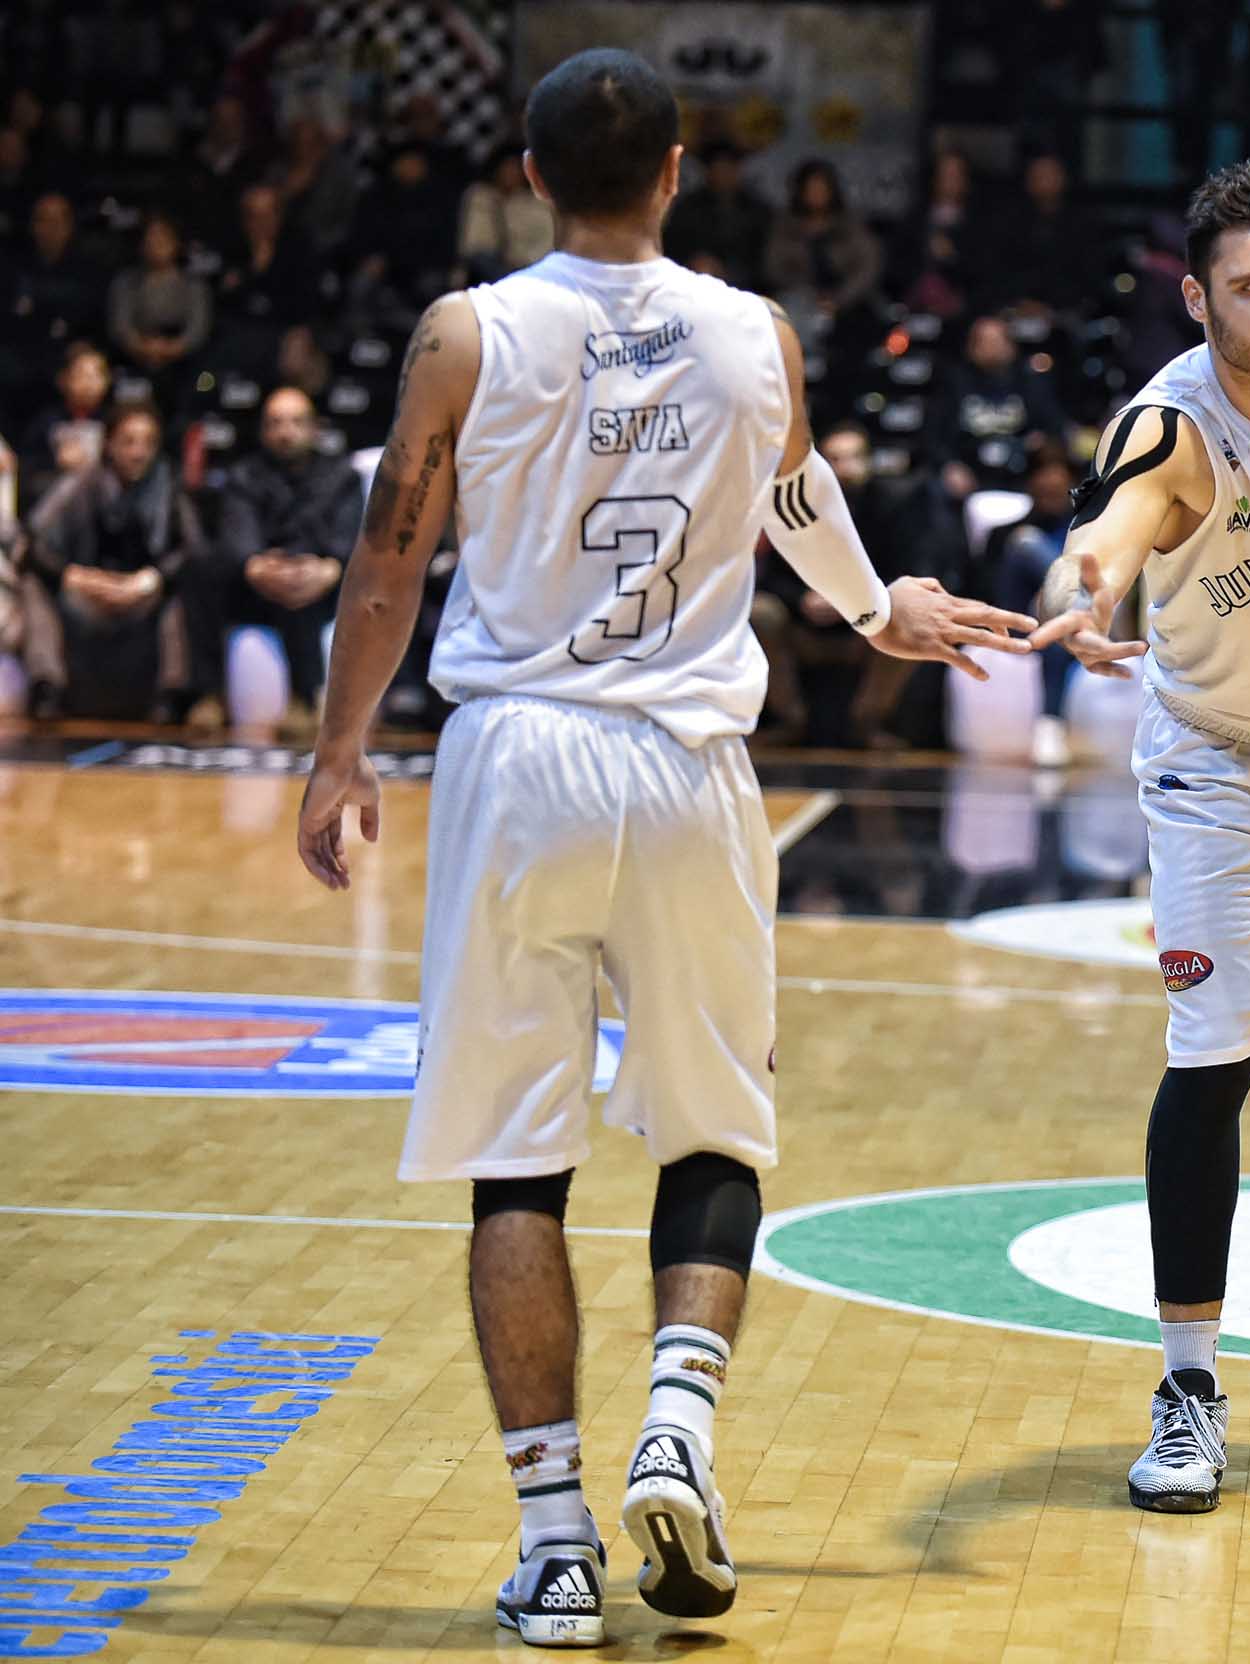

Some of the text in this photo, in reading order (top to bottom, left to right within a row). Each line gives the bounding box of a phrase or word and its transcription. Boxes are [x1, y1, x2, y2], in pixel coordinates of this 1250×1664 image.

[567, 495, 691, 665] 3
[633, 1456, 688, 1478] adidas
[541, 1592, 596, 1609] adidas
